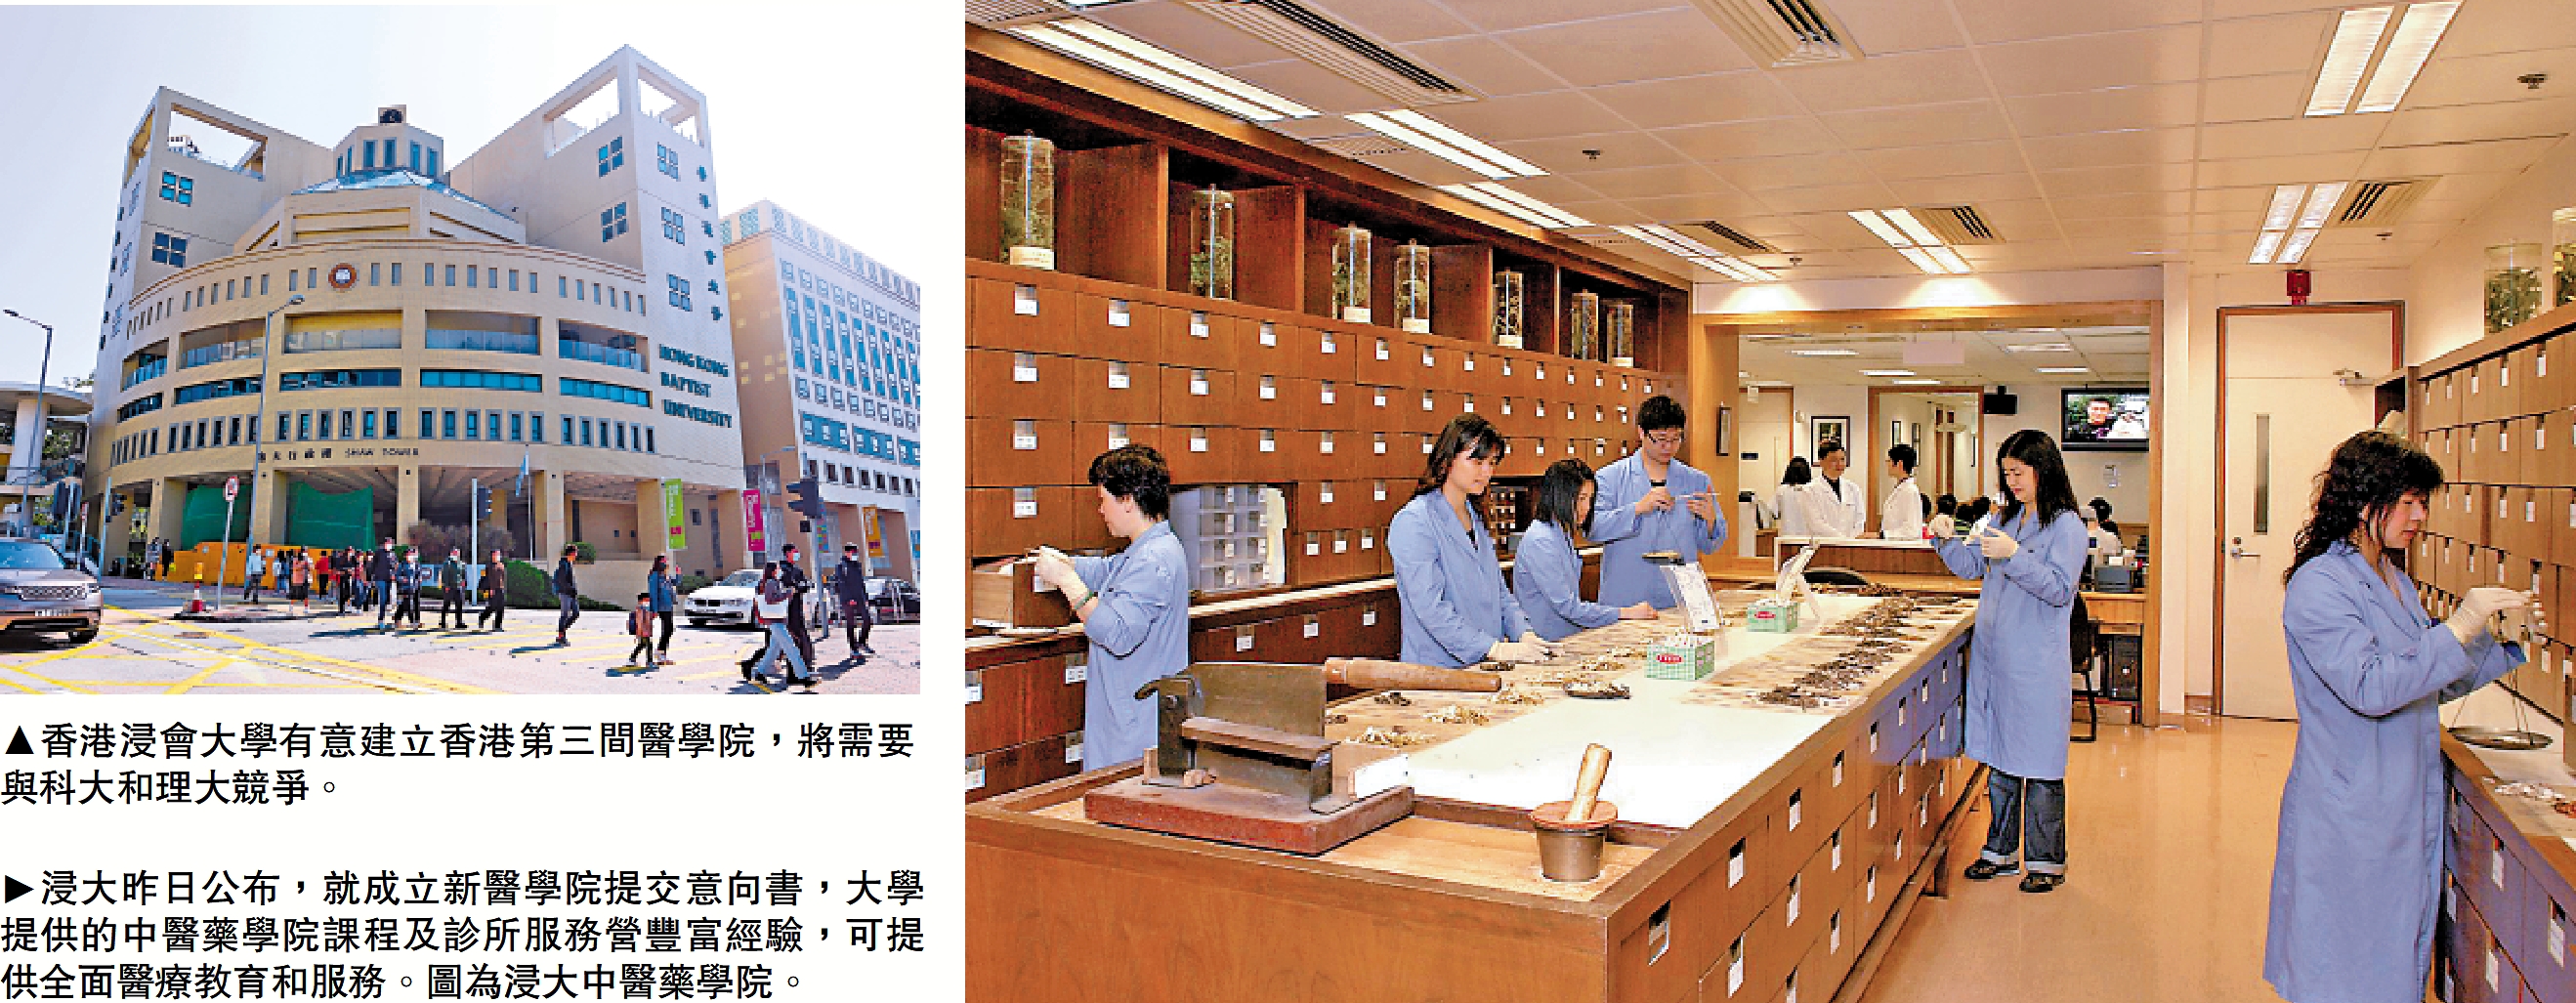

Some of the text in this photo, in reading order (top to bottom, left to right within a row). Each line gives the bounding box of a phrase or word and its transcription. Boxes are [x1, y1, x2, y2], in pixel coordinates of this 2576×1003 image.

[658, 344, 729, 377] HONG KONG
[660, 372, 711, 397] BAPTIST
[662, 399, 732, 428] UNIVERSITY
